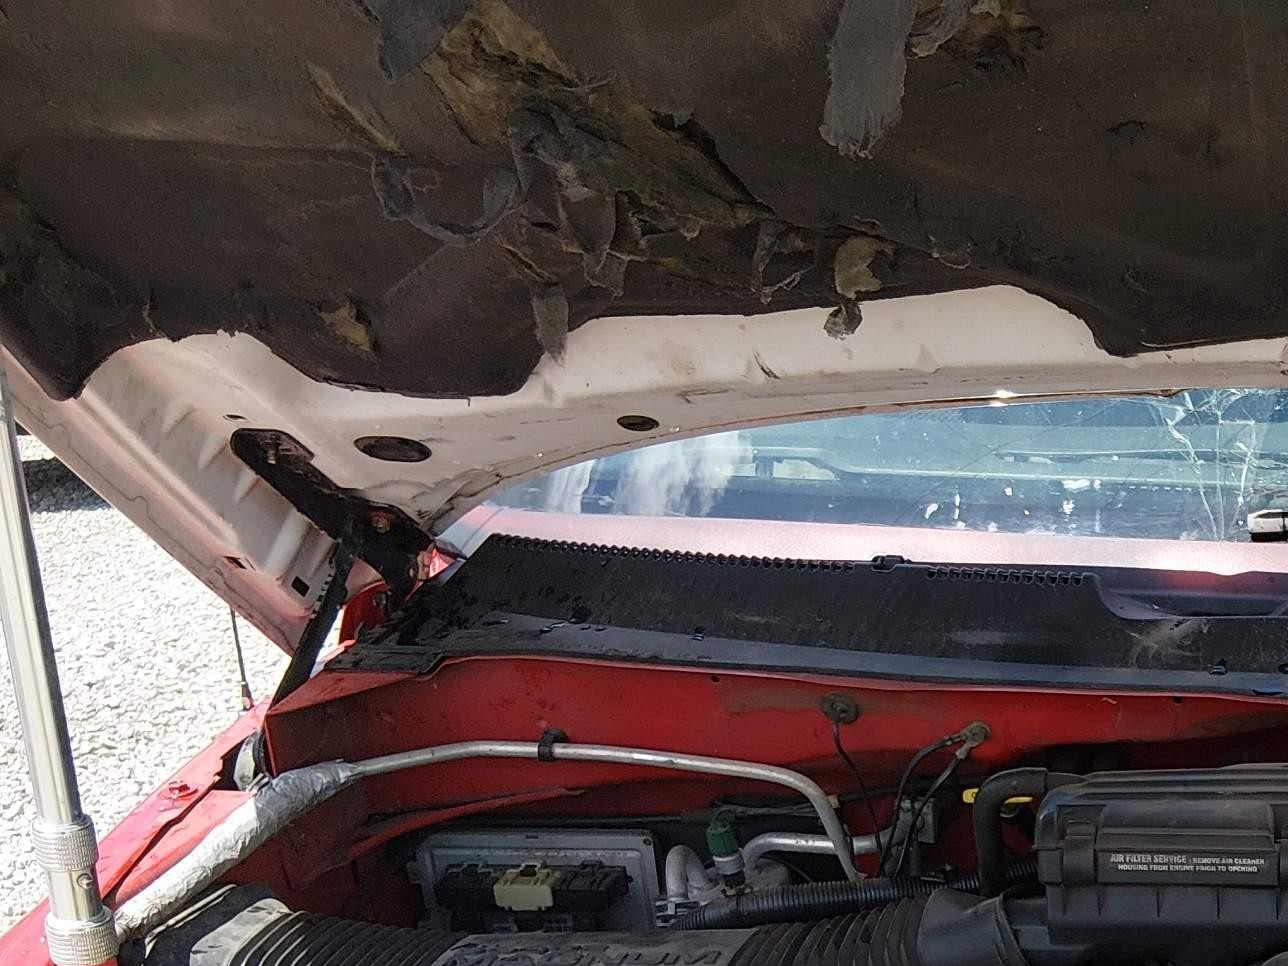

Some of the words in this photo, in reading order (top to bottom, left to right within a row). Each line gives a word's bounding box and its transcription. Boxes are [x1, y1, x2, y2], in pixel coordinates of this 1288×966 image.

[1110, 854, 1124, 863] AIR
[1126, 854, 1151, 863] FILTER
[1153, 855, 1187, 864] SERVICE
